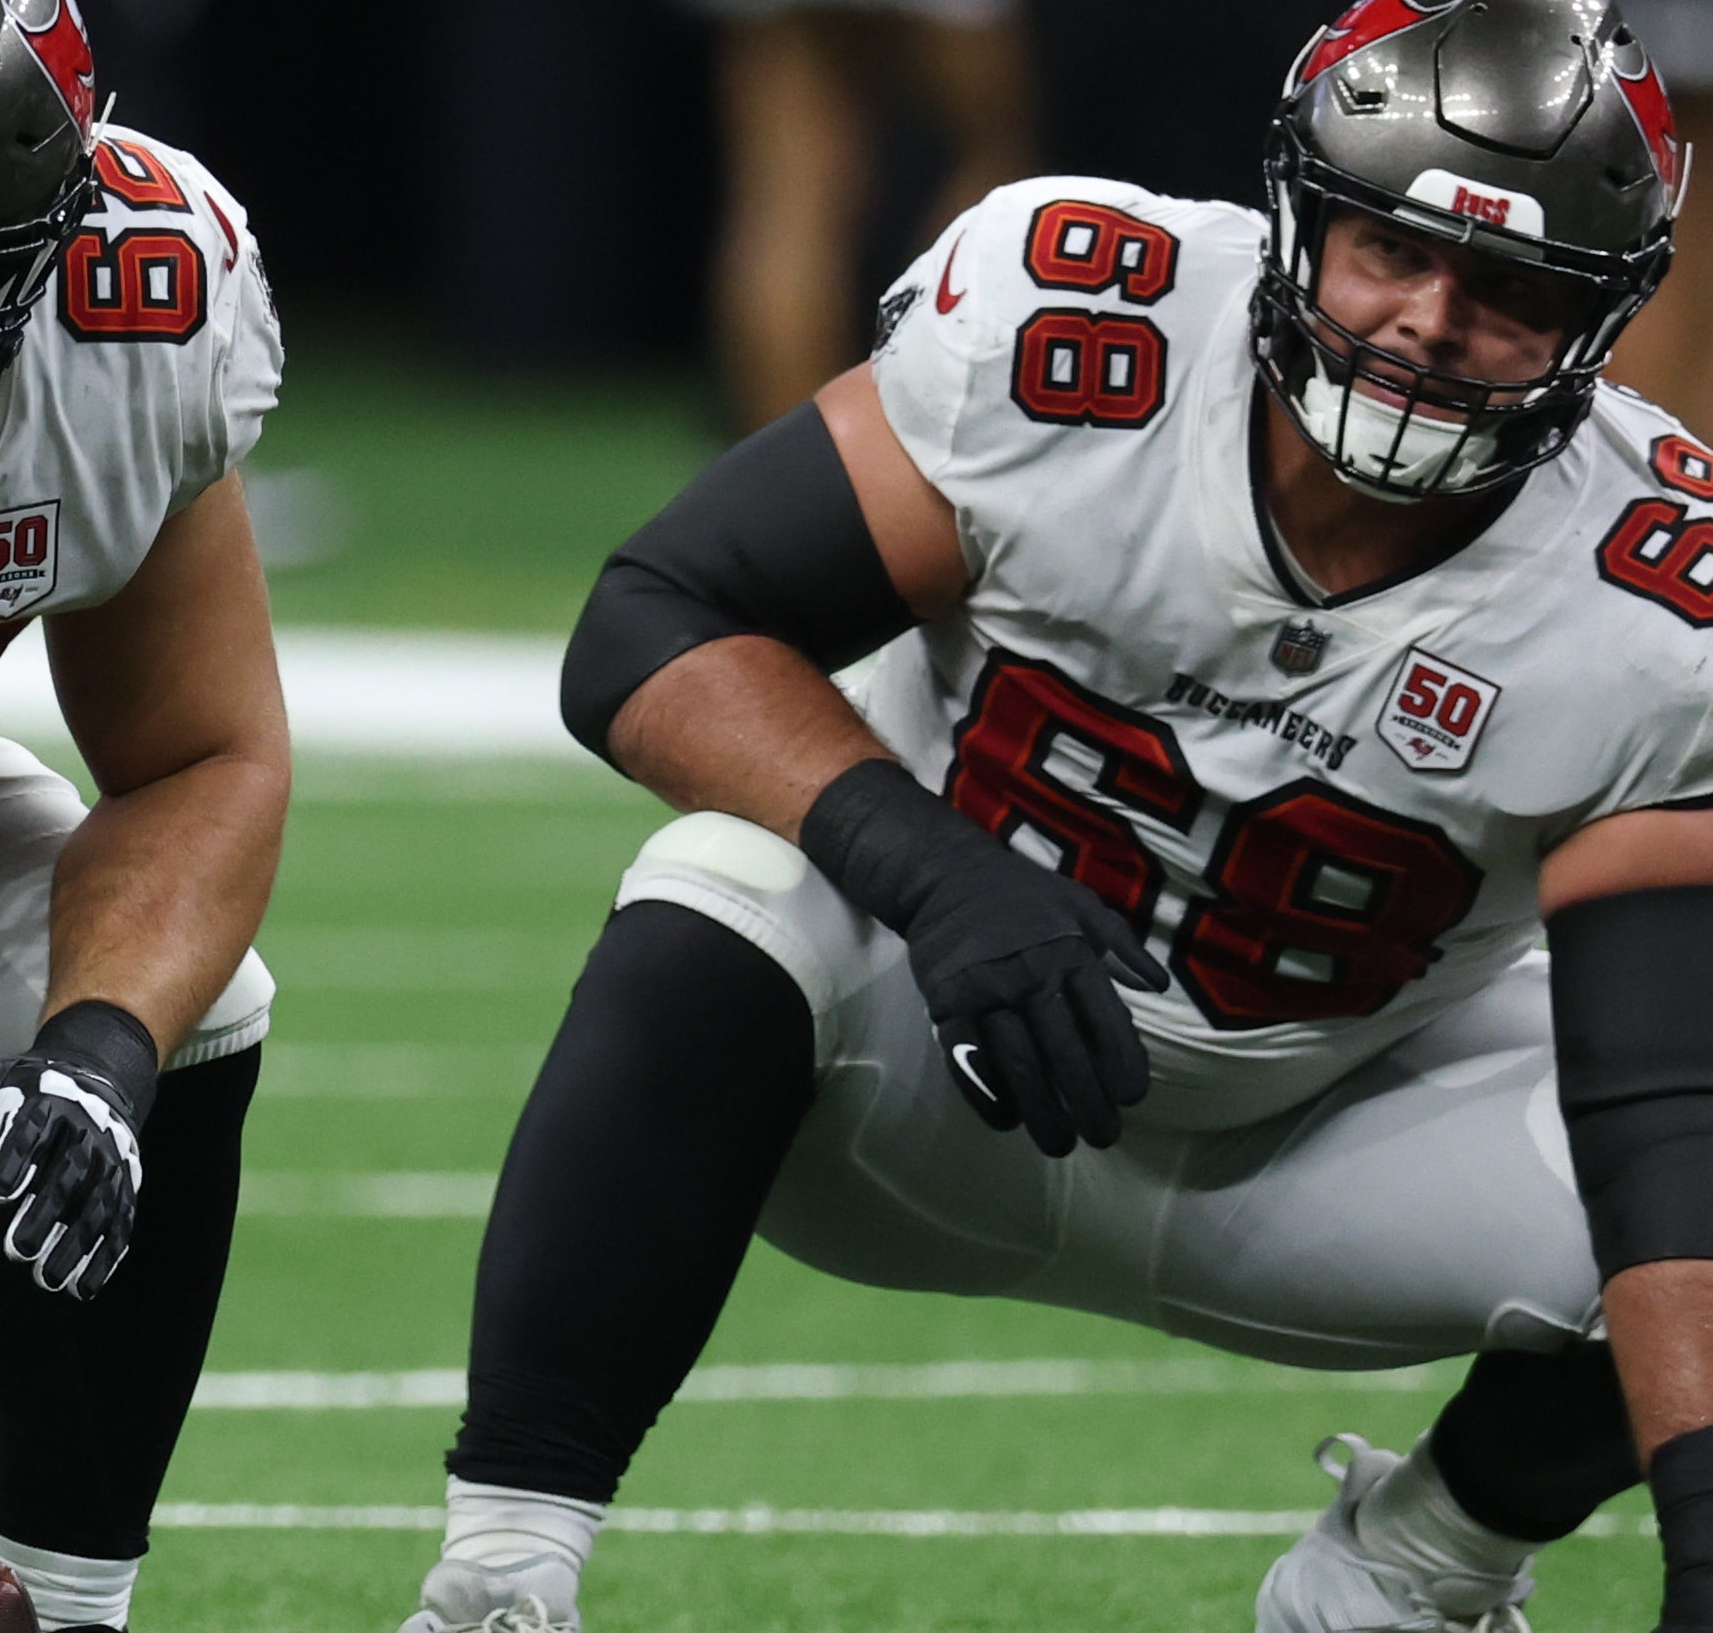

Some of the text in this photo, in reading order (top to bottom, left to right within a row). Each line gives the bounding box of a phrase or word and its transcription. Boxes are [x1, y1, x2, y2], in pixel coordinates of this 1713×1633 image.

[1452, 185, 1511, 225] BUCS
[1010, 199, 1181, 430] 68
[1164, 671, 1358, 771] BUCCANEERS
[1397, 663, 1482, 737] 50
[942, 646, 1485, 1031] 68
